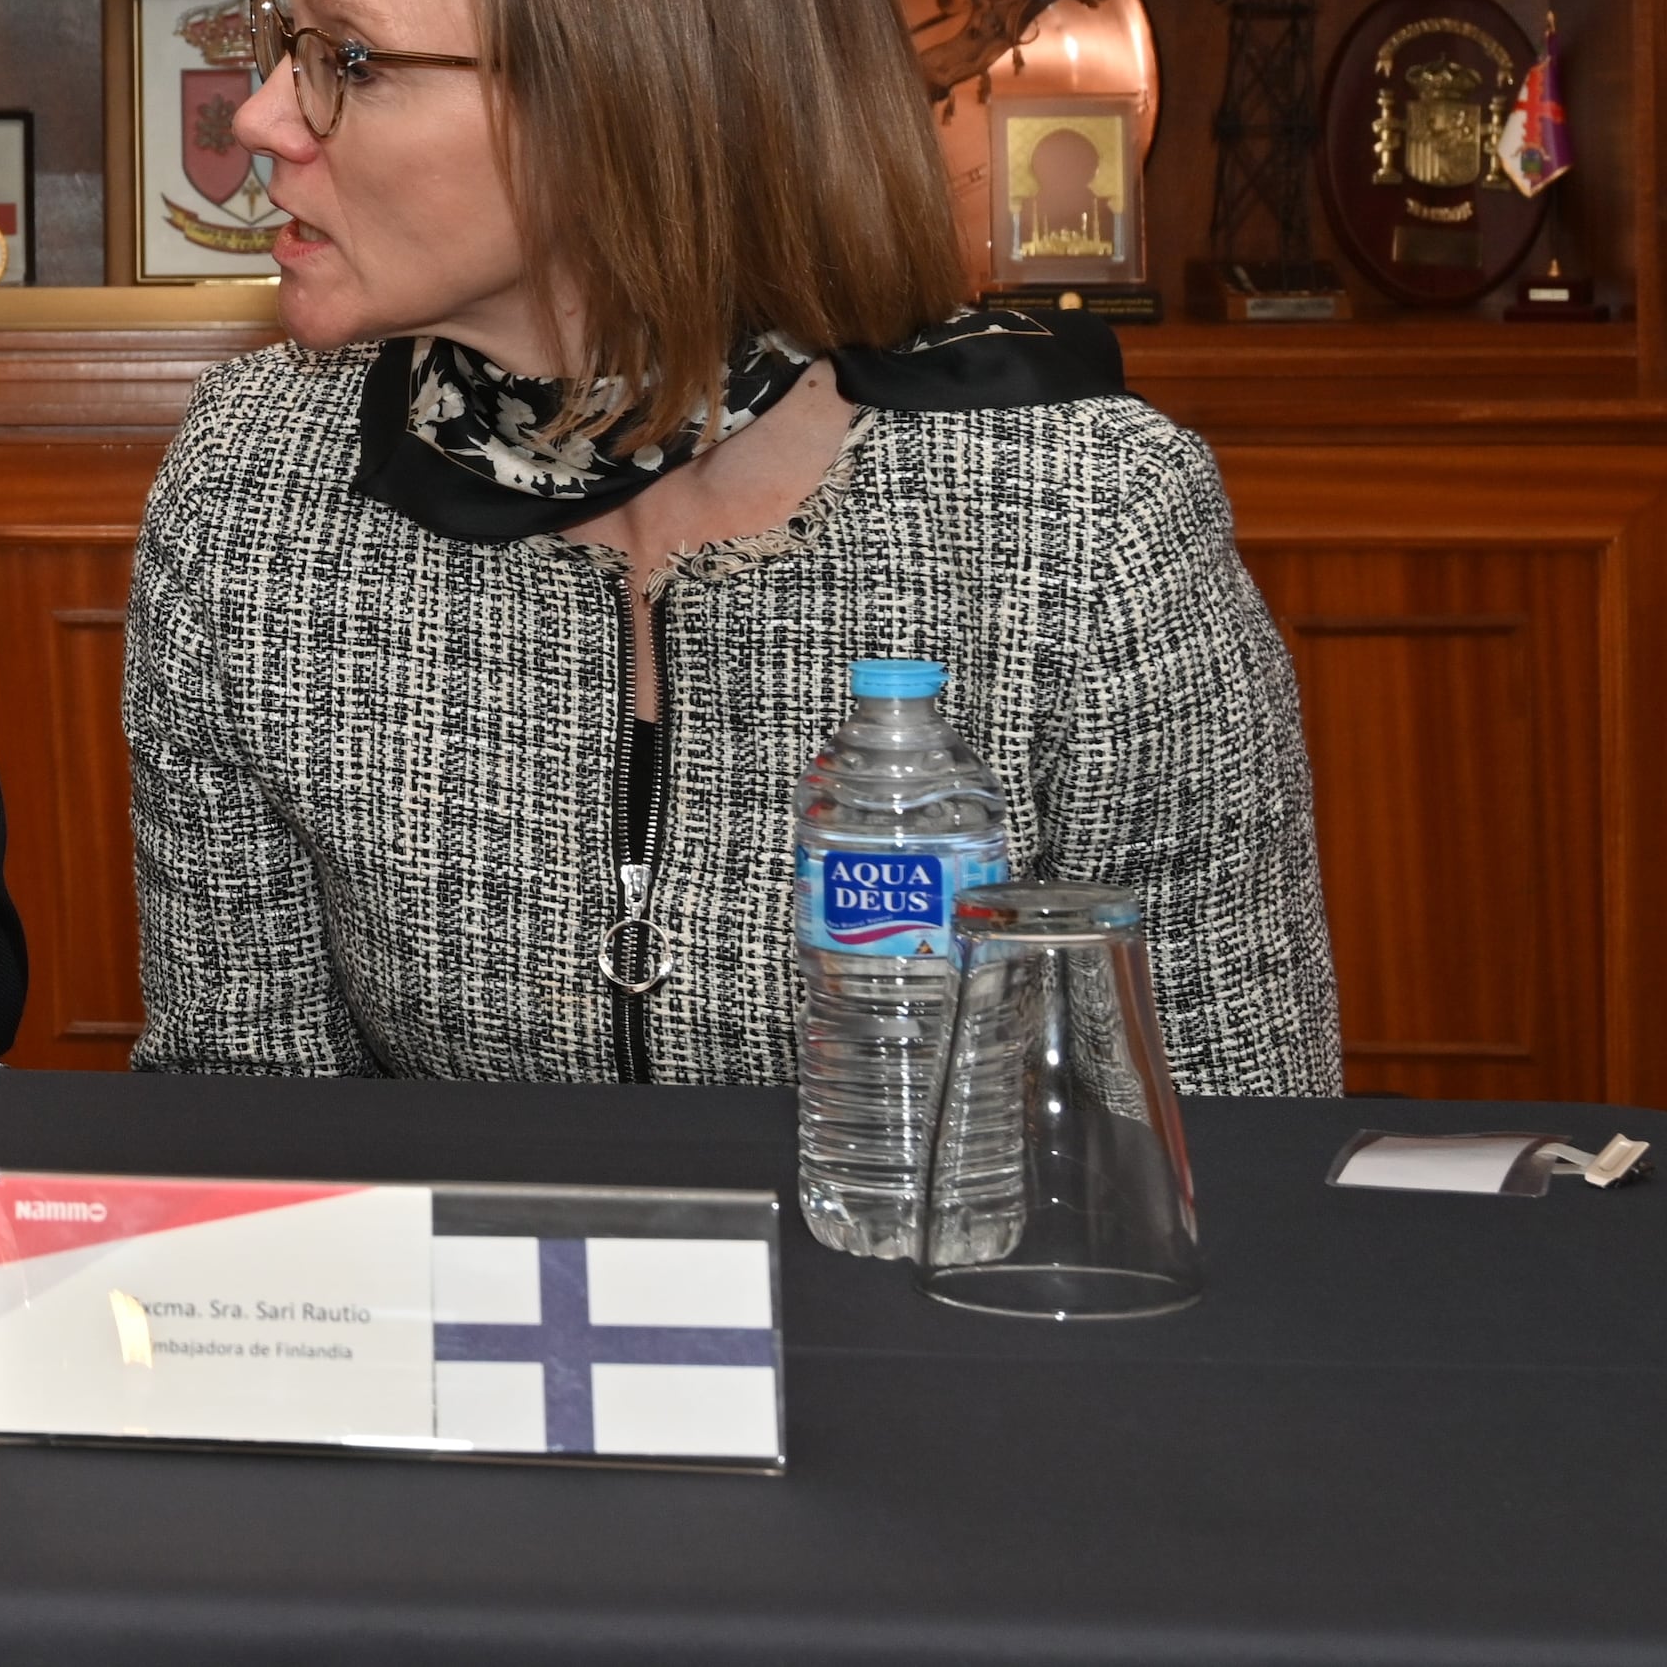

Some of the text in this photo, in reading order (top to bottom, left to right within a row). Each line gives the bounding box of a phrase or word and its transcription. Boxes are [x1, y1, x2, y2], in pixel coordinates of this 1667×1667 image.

[830, 861, 933, 888] AQUA
[834, 886, 930, 913] DEUS
[14, 1199, 108, 1223] Nammo
[137, 1296, 372, 1324] xcma. Sra. Sari Rautio
[151, 1338, 354, 1360] mbajadora de Finlandia
